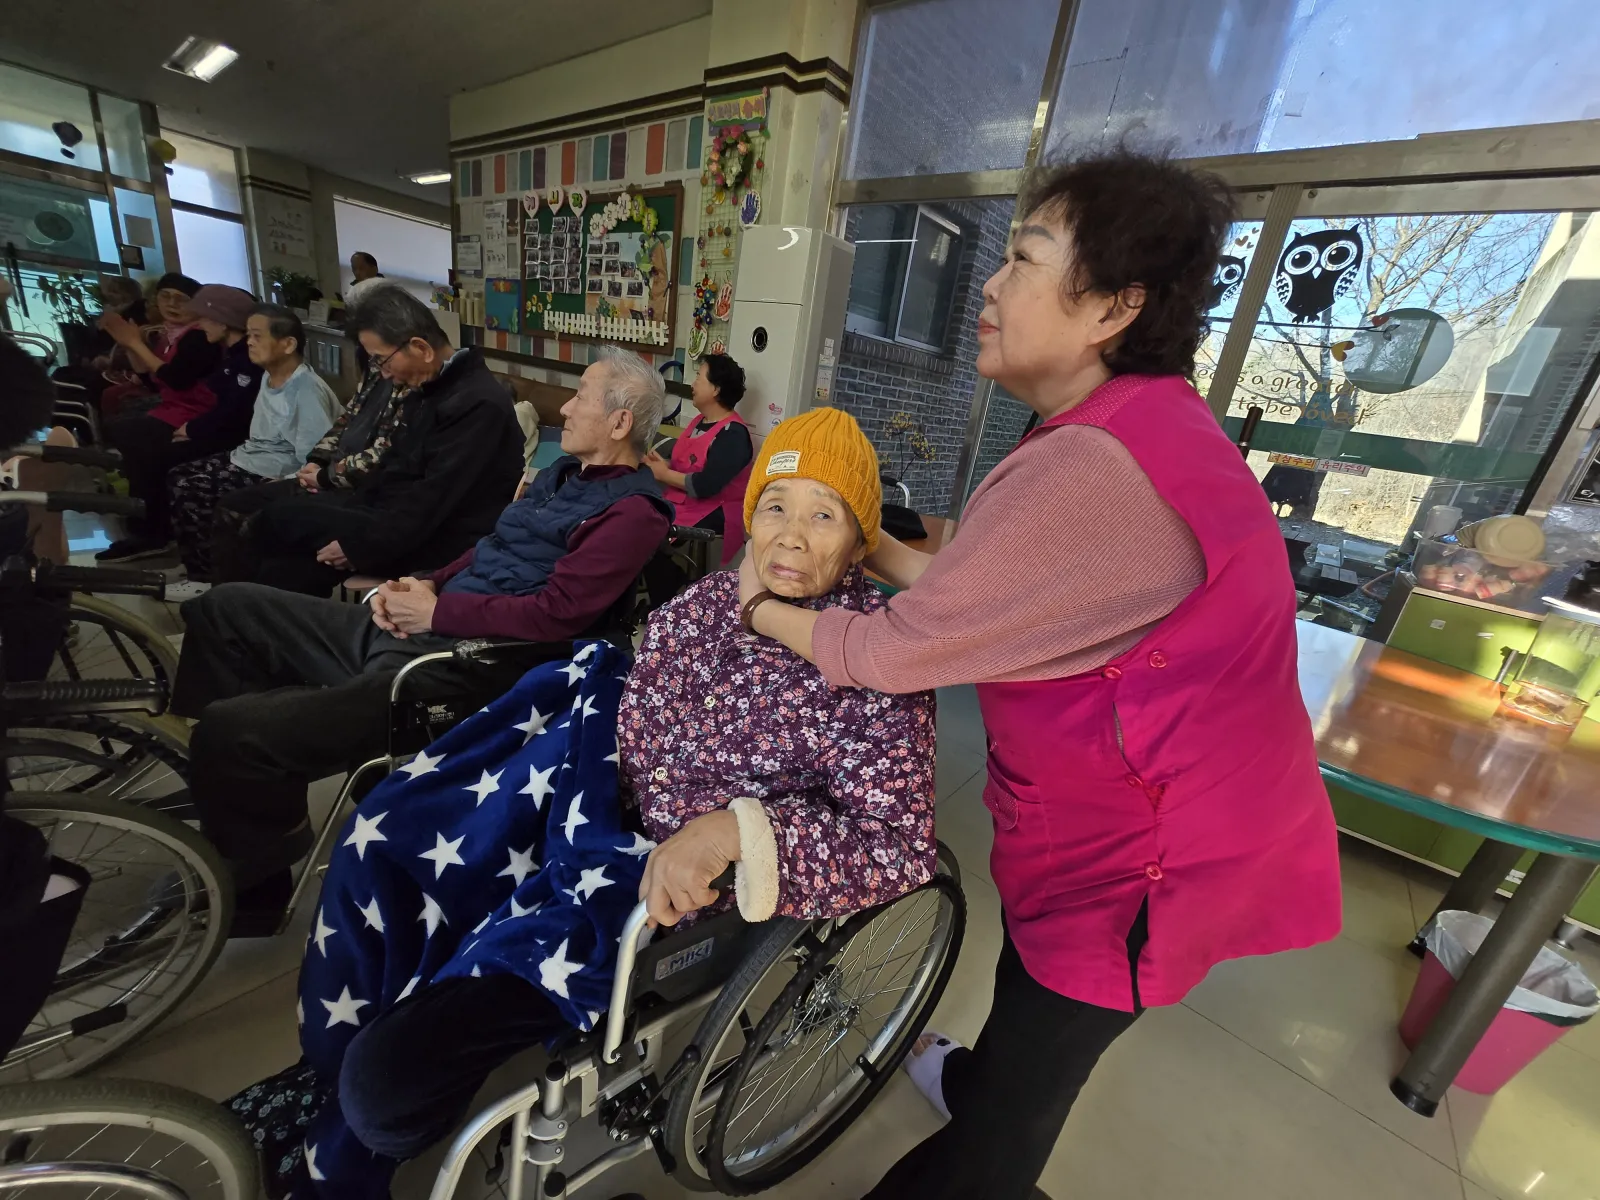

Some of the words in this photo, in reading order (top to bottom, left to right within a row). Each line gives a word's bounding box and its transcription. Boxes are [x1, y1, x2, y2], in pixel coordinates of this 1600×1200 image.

[1251, 374, 1264, 385] a
[1270, 376, 1356, 395] greater
[1237, 396, 1257, 411] to
[1265, 399, 1293, 416] be
[1300, 403, 1368, 425] loved
[670, 944, 710, 970] MIKI
